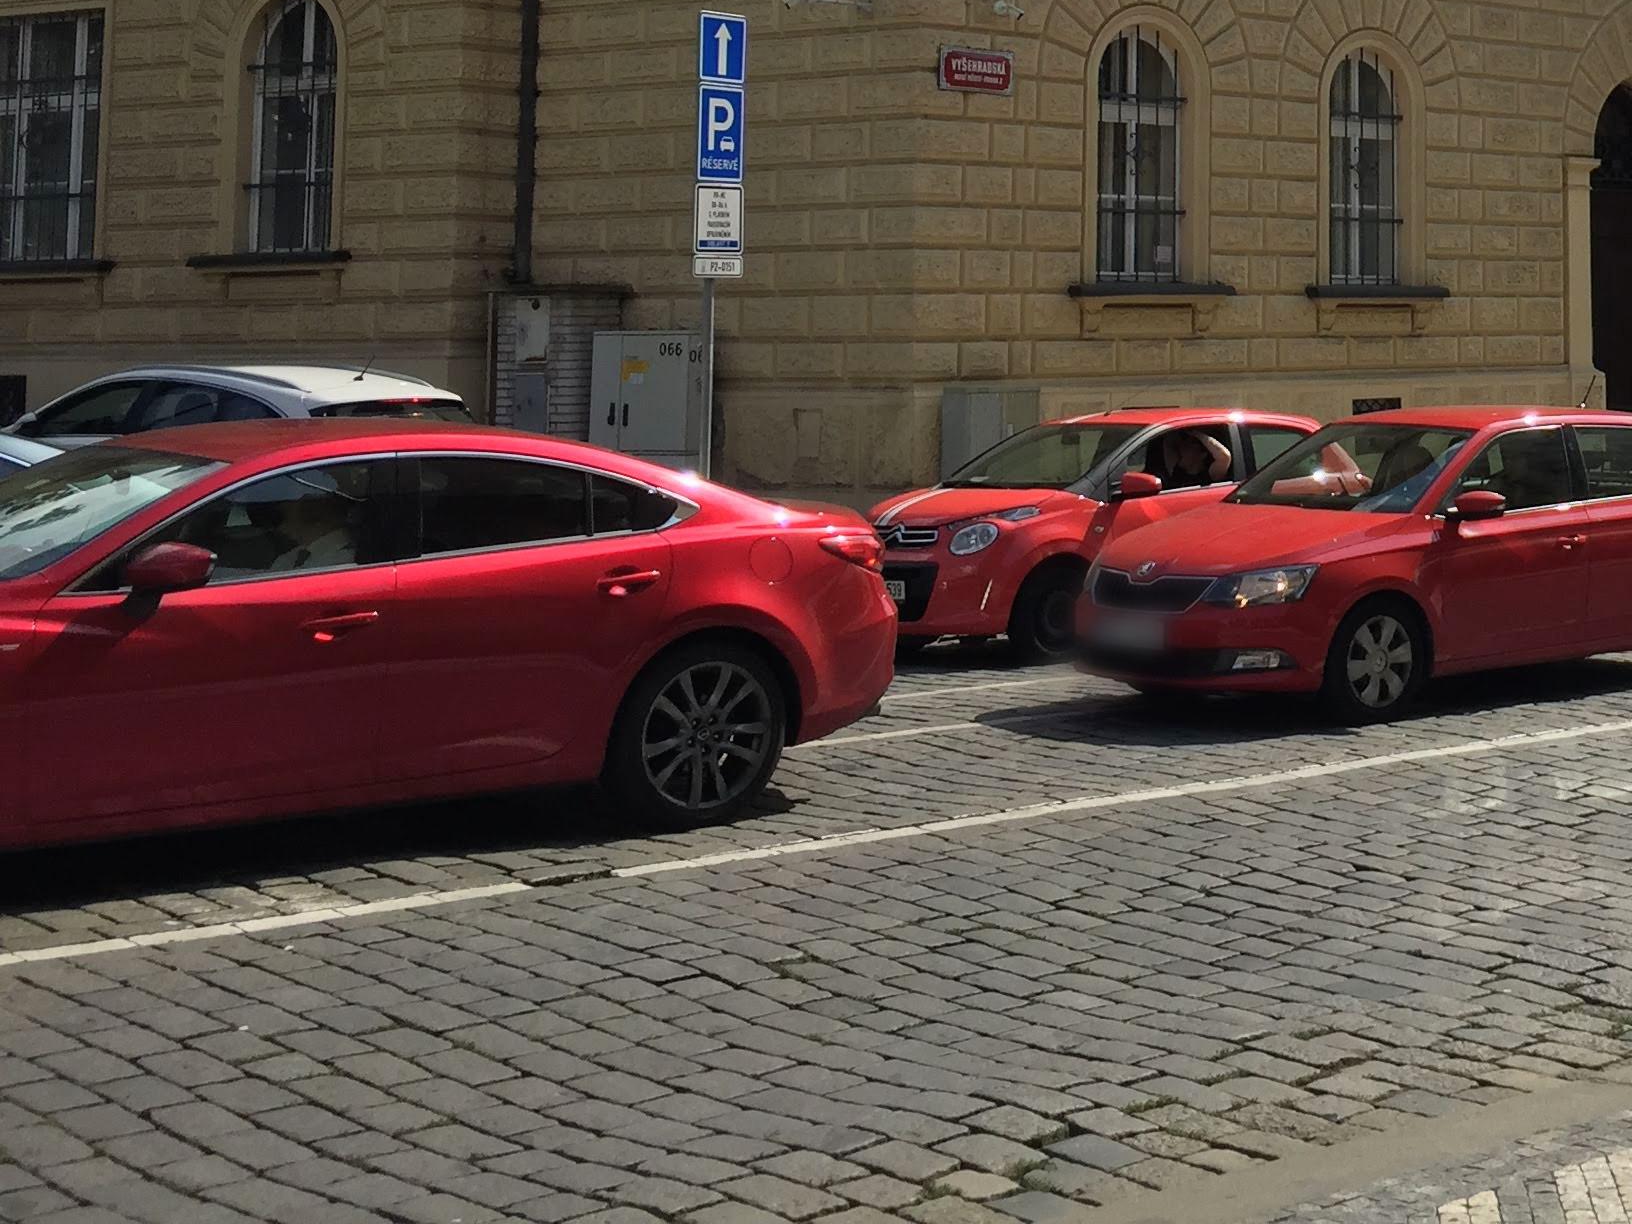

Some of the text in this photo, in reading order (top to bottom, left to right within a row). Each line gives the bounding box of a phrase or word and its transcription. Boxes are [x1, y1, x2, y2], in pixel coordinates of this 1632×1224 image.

[951, 57, 1006, 75] VYŠEHRADSKÁ
[707, 97, 735, 151] P
[701, 156, 738, 171] RÉSERVÉ
